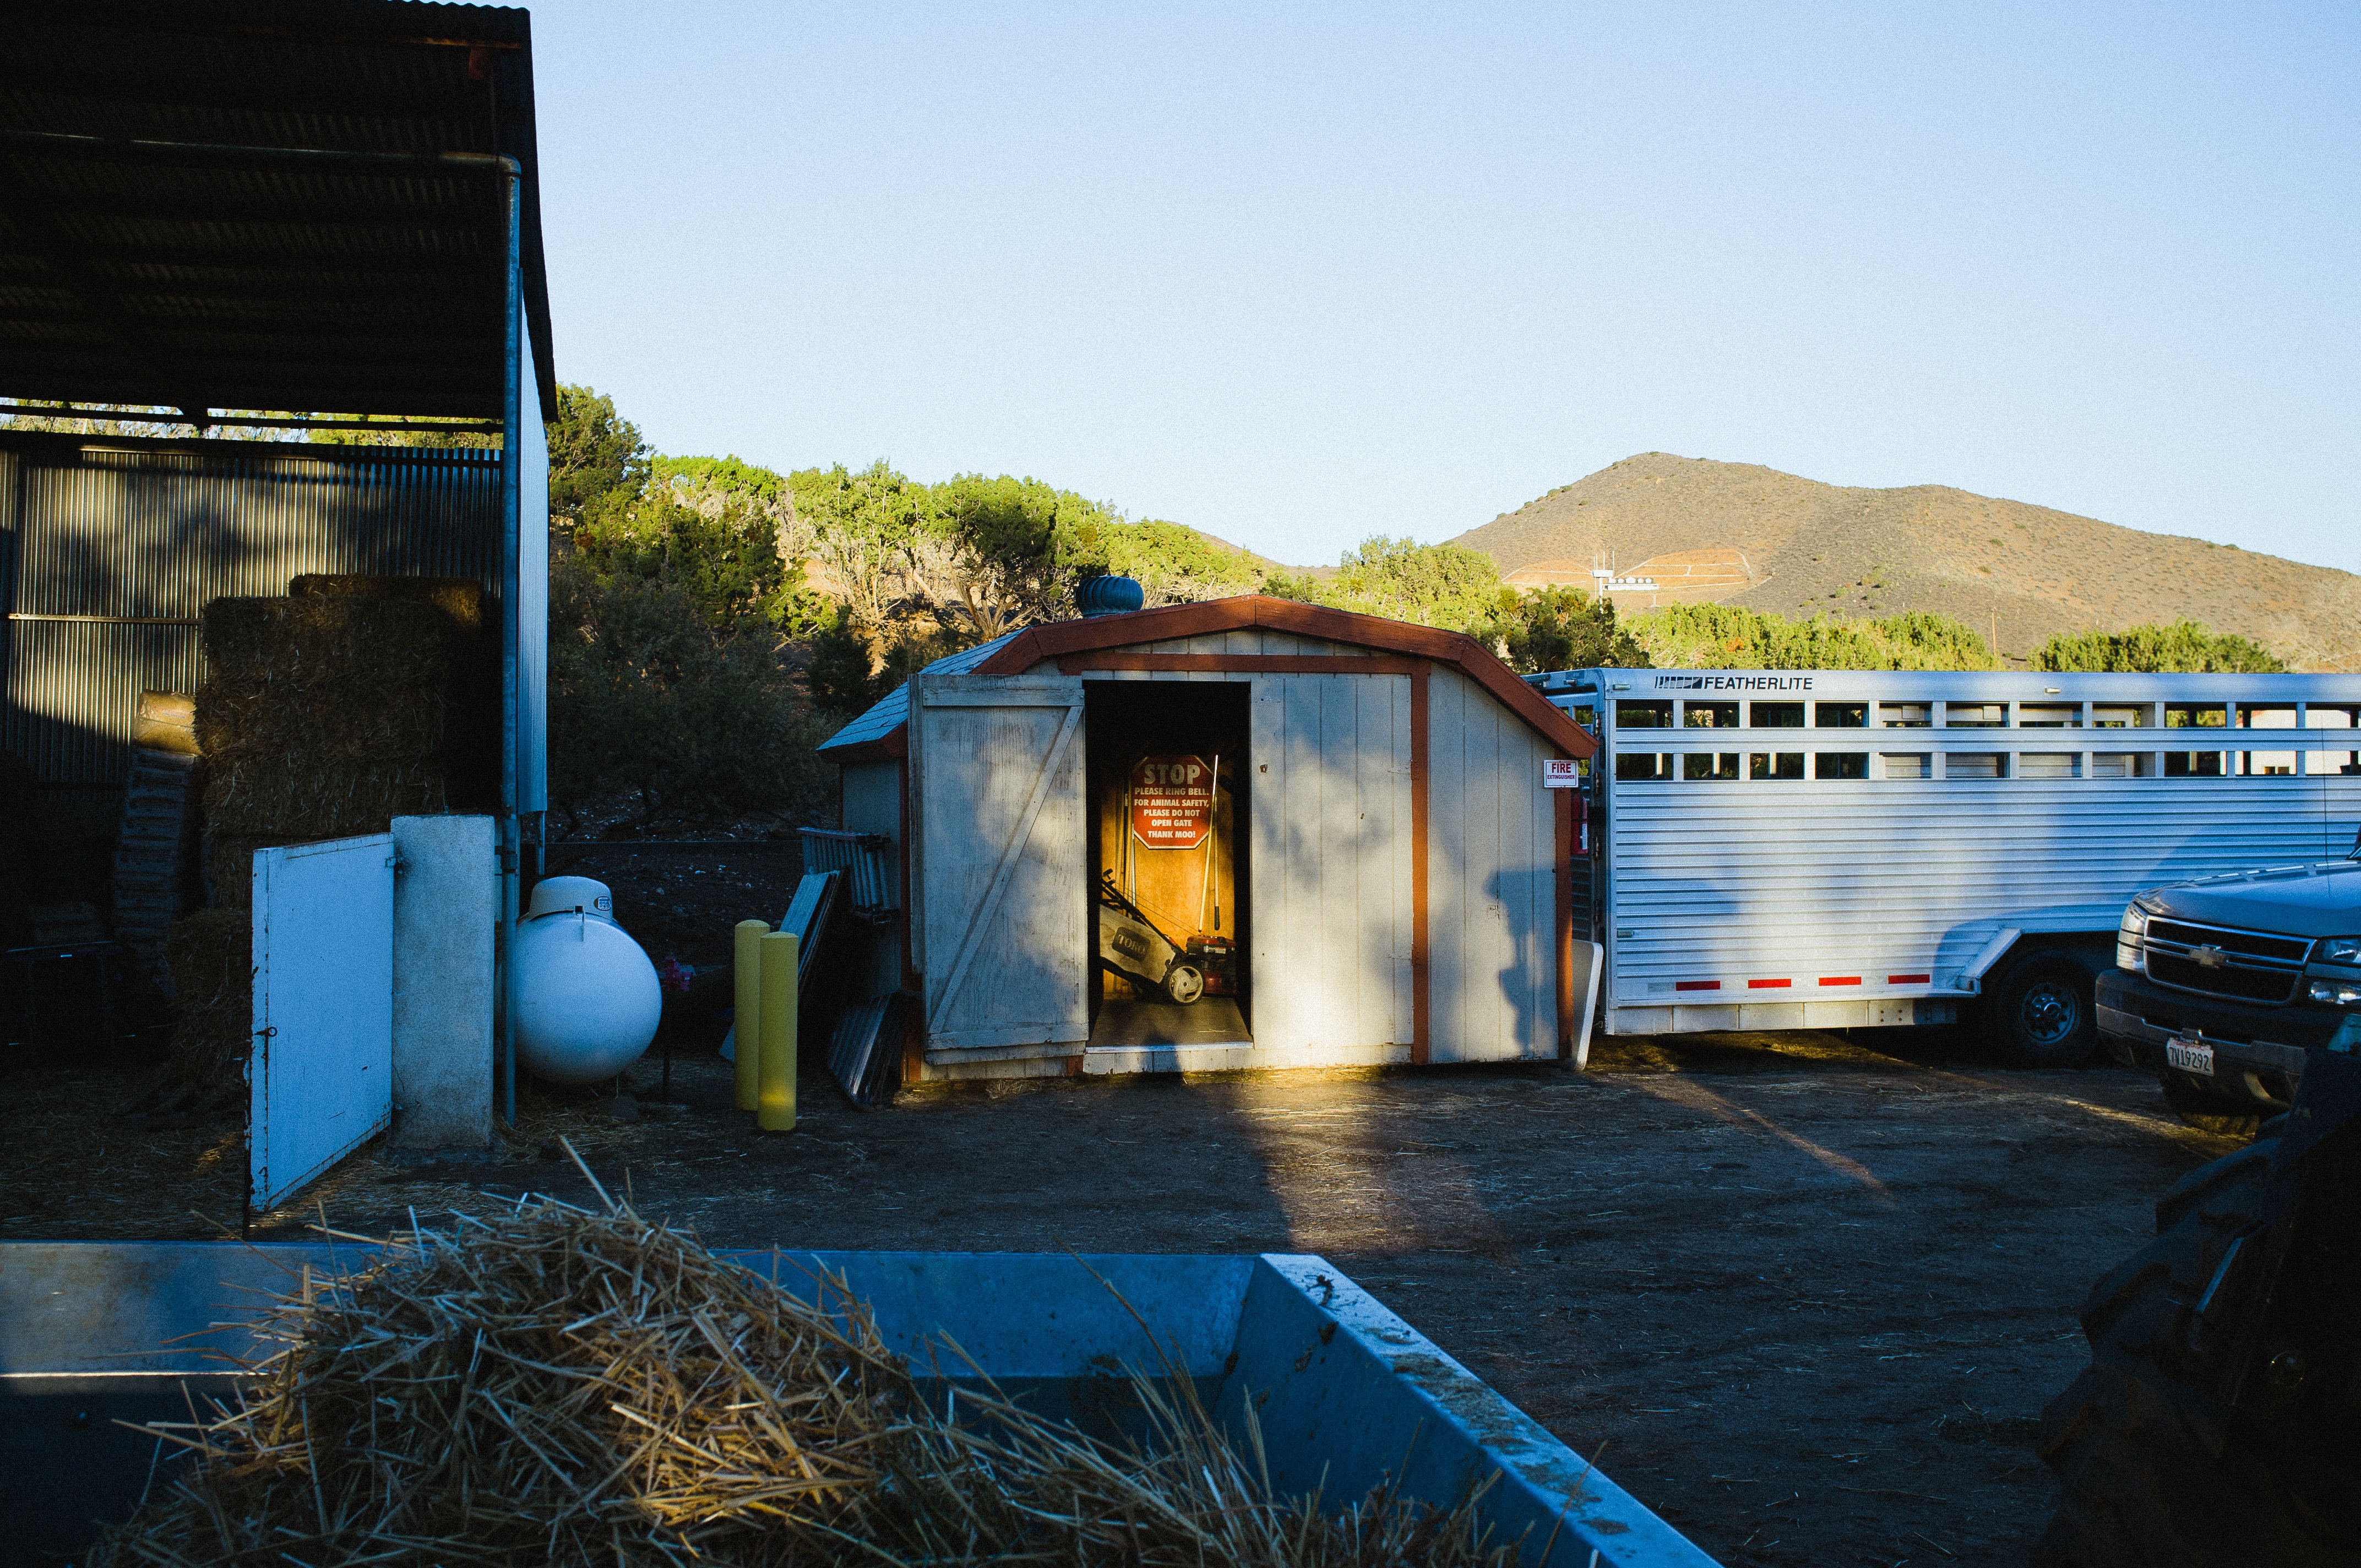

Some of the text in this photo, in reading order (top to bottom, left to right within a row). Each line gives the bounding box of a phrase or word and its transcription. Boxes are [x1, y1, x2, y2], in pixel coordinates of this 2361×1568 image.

[1704, 677, 1813, 689] FEATHERLITE
[1144, 764, 1200, 785] STOP
[1552, 763, 1571, 773] FIRE
[1182, 799, 1209, 808] SAFETY,
[1118, 934, 1145, 952] TORO
[2169, 1047, 2210, 1072] 7N19292
